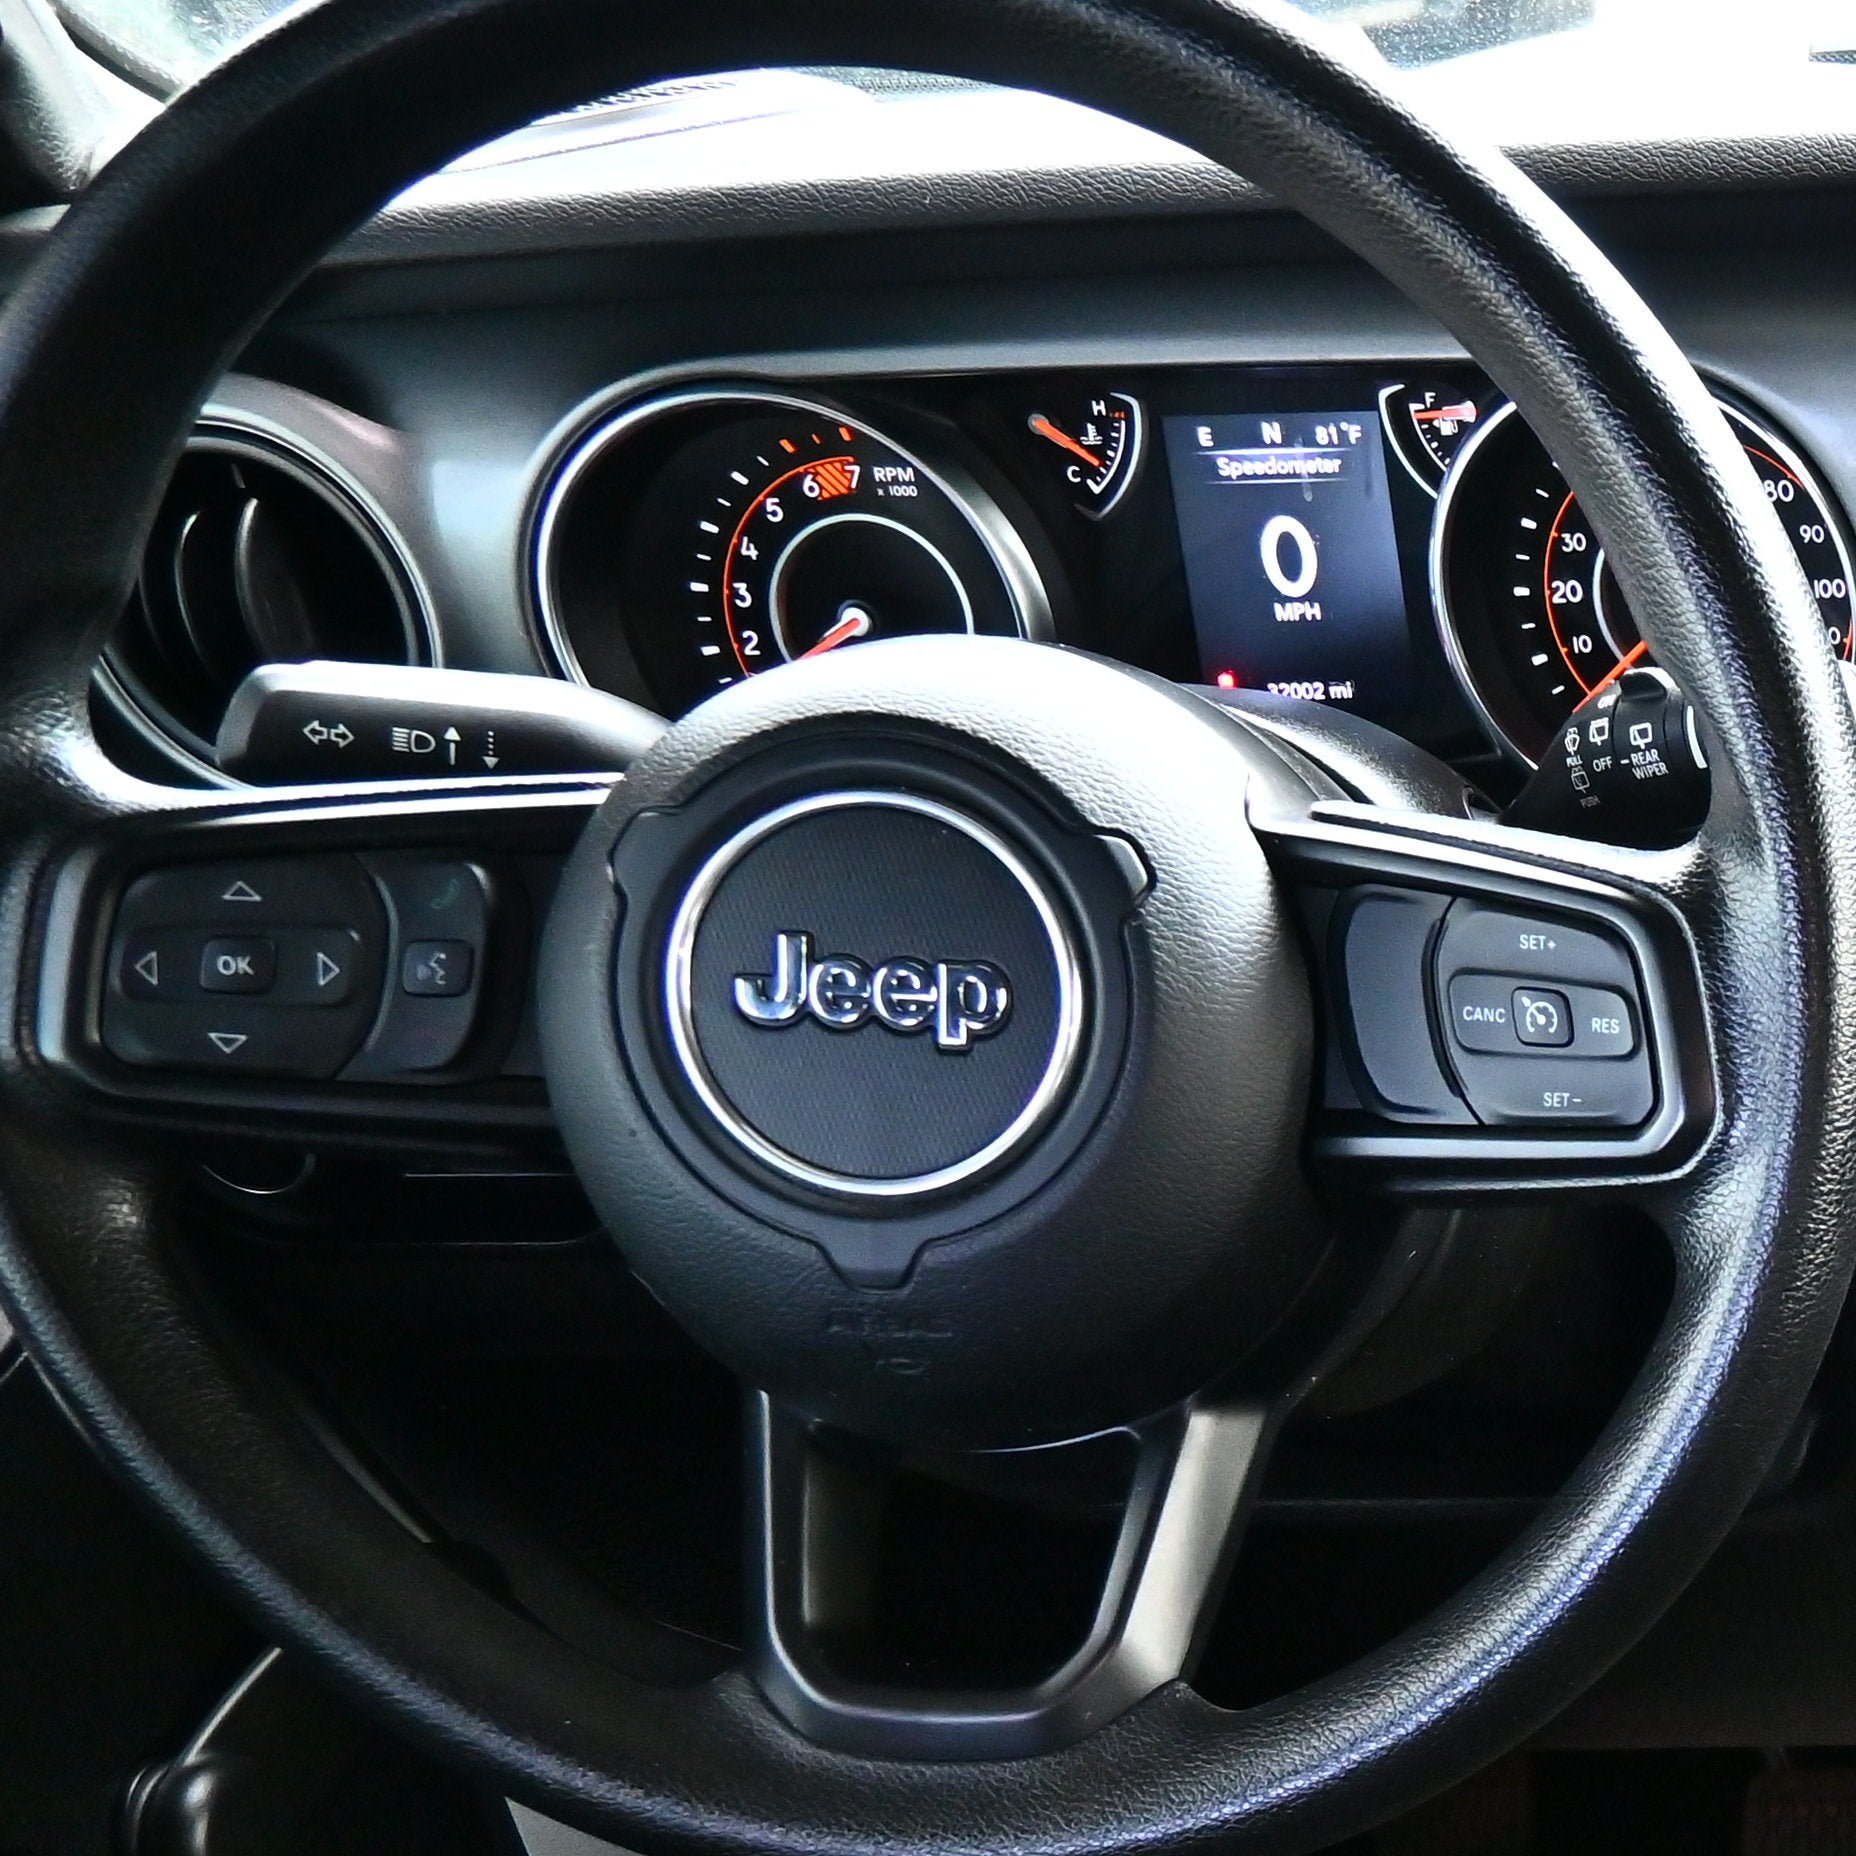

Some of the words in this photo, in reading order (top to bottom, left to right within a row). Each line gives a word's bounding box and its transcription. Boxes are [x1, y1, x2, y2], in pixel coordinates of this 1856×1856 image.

[1092, 400, 1106, 416] H
[1424, 392, 1436, 408] F
[1196, 426, 1214, 447] E
[1261, 422, 1282, 445] N
[1315, 422, 1362, 445] 81°F
[844, 465, 861, 489] 7
[873, 467, 916, 483] RPM
[1067, 466, 1082, 483] C
[1216, 456, 1342, 480] Speedometer
[802, 473, 820, 497] 6
[889, 485, 918, 497] 1000
[1763, 480, 1795, 503] 80
[765, 497, 784, 523] 5
[1561, 532, 1587, 552] 30
[1800, 525, 1825, 544] 90
[740, 536, 759, 560] 4
[1260, 514, 1318, 598] 0
[733, 582, 752, 608] 3
[1551, 581, 1583, 604] 20
[1813, 578, 1846, 599] 100
[1274, 602, 1322, 622] MPH
[742, 630, 761, 656] 2
[1572, 635, 1593, 654] 10
[1328, 681, 1353, 700] mi
[1592, 756, 1613, 773] OFF
[1630, 749, 1661, 767] REAR
[1631, 762, 1669, 780] WIPER
[217, 955, 254, 976] OK
[734, 930, 1012, 1054] Jeep
[1462, 1005, 1506, 1024] CANC
[1591, 1016, 1620, 1035] RES
